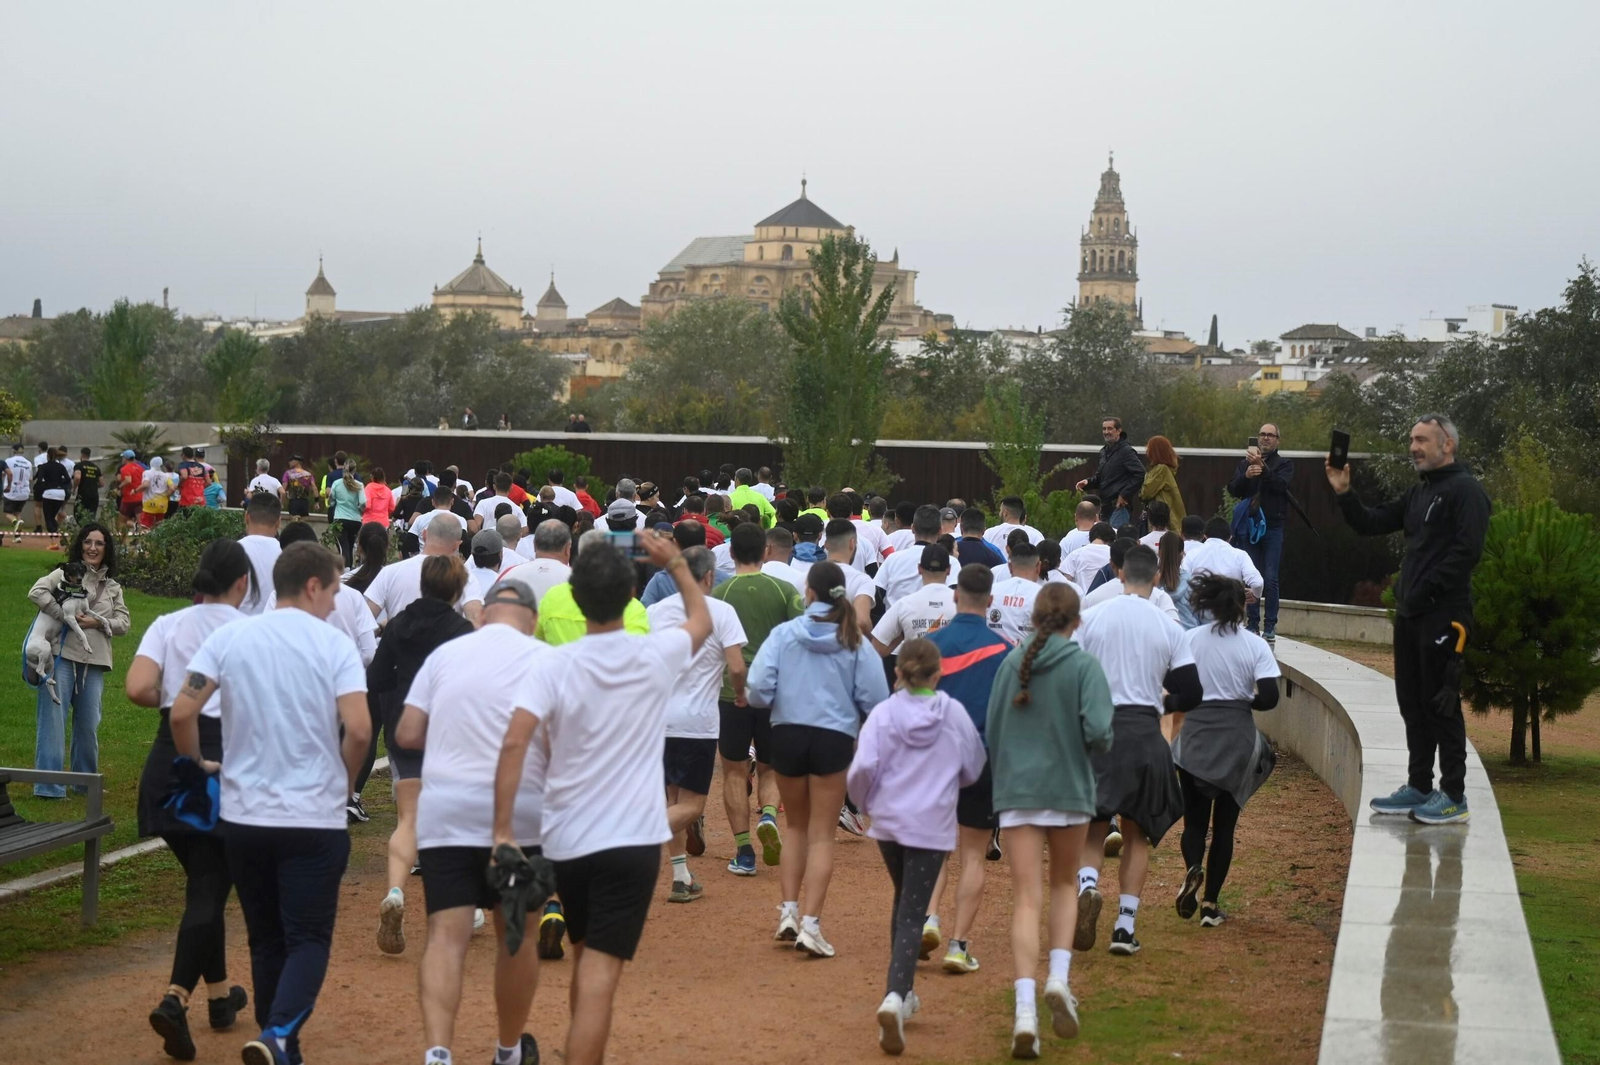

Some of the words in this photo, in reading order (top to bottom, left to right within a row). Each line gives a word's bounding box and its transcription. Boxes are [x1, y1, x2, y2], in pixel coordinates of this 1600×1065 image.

[1003, 595, 1025, 608] RIZO
[911, 618, 927, 629] SHARE
[928, 618, 941, 628] YOUR
